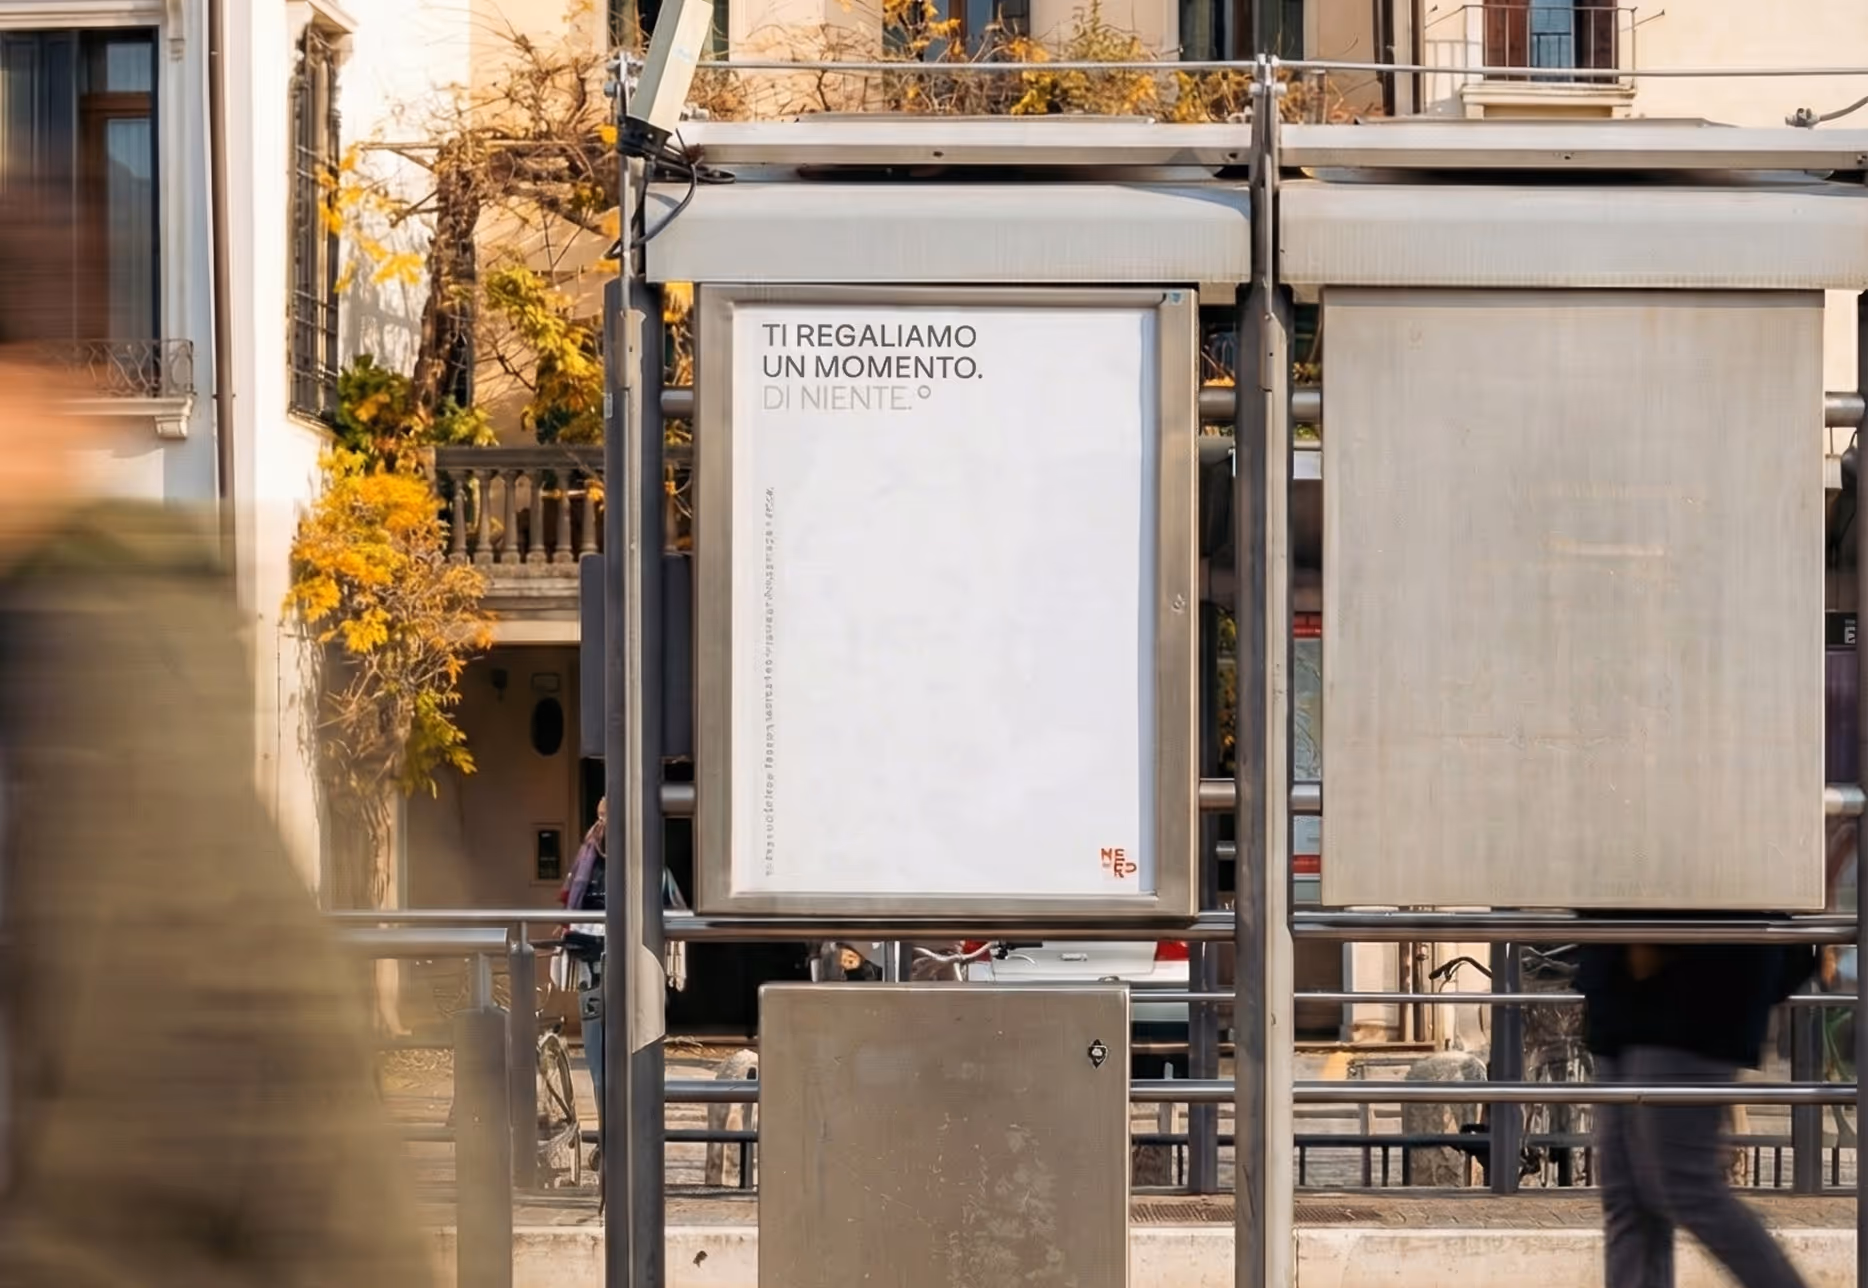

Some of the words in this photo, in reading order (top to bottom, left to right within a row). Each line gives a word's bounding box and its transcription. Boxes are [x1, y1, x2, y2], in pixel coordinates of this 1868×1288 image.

[762, 323, 787, 347] TI
[796, 323, 977, 348] REGALIAMO
[763, 355, 805, 378] UN
[815, 355, 983, 379] MOMENTO.
[763, 385, 790, 410] DI
